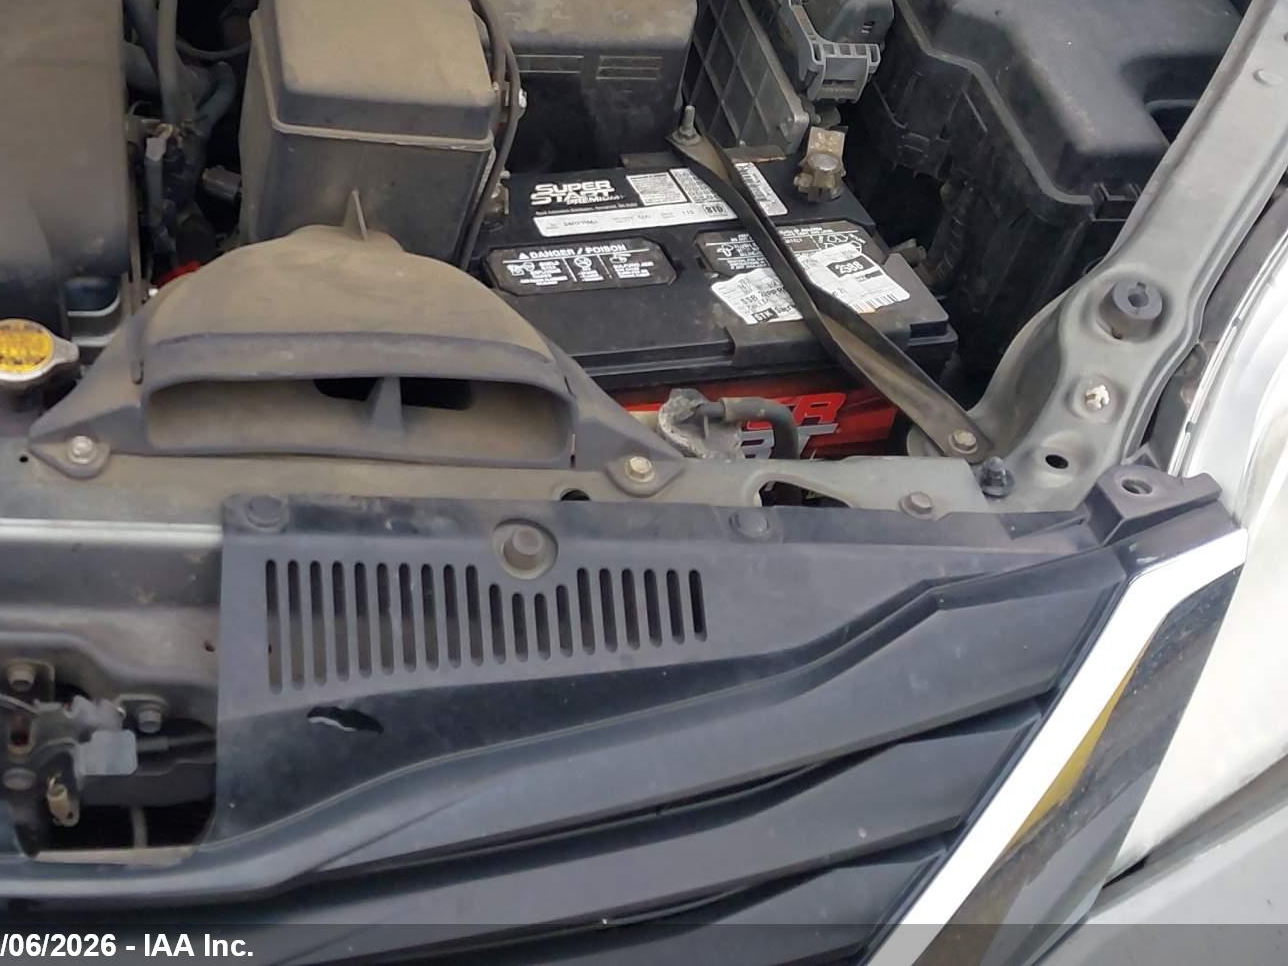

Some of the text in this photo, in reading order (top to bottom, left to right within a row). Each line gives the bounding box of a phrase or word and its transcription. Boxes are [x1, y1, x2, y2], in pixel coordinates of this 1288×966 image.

[535, 180, 611, 194] SUPER
[530, 189, 616, 206] START
[529, 248, 575, 260] DANGER
[584, 244, 627, 254] POISON
